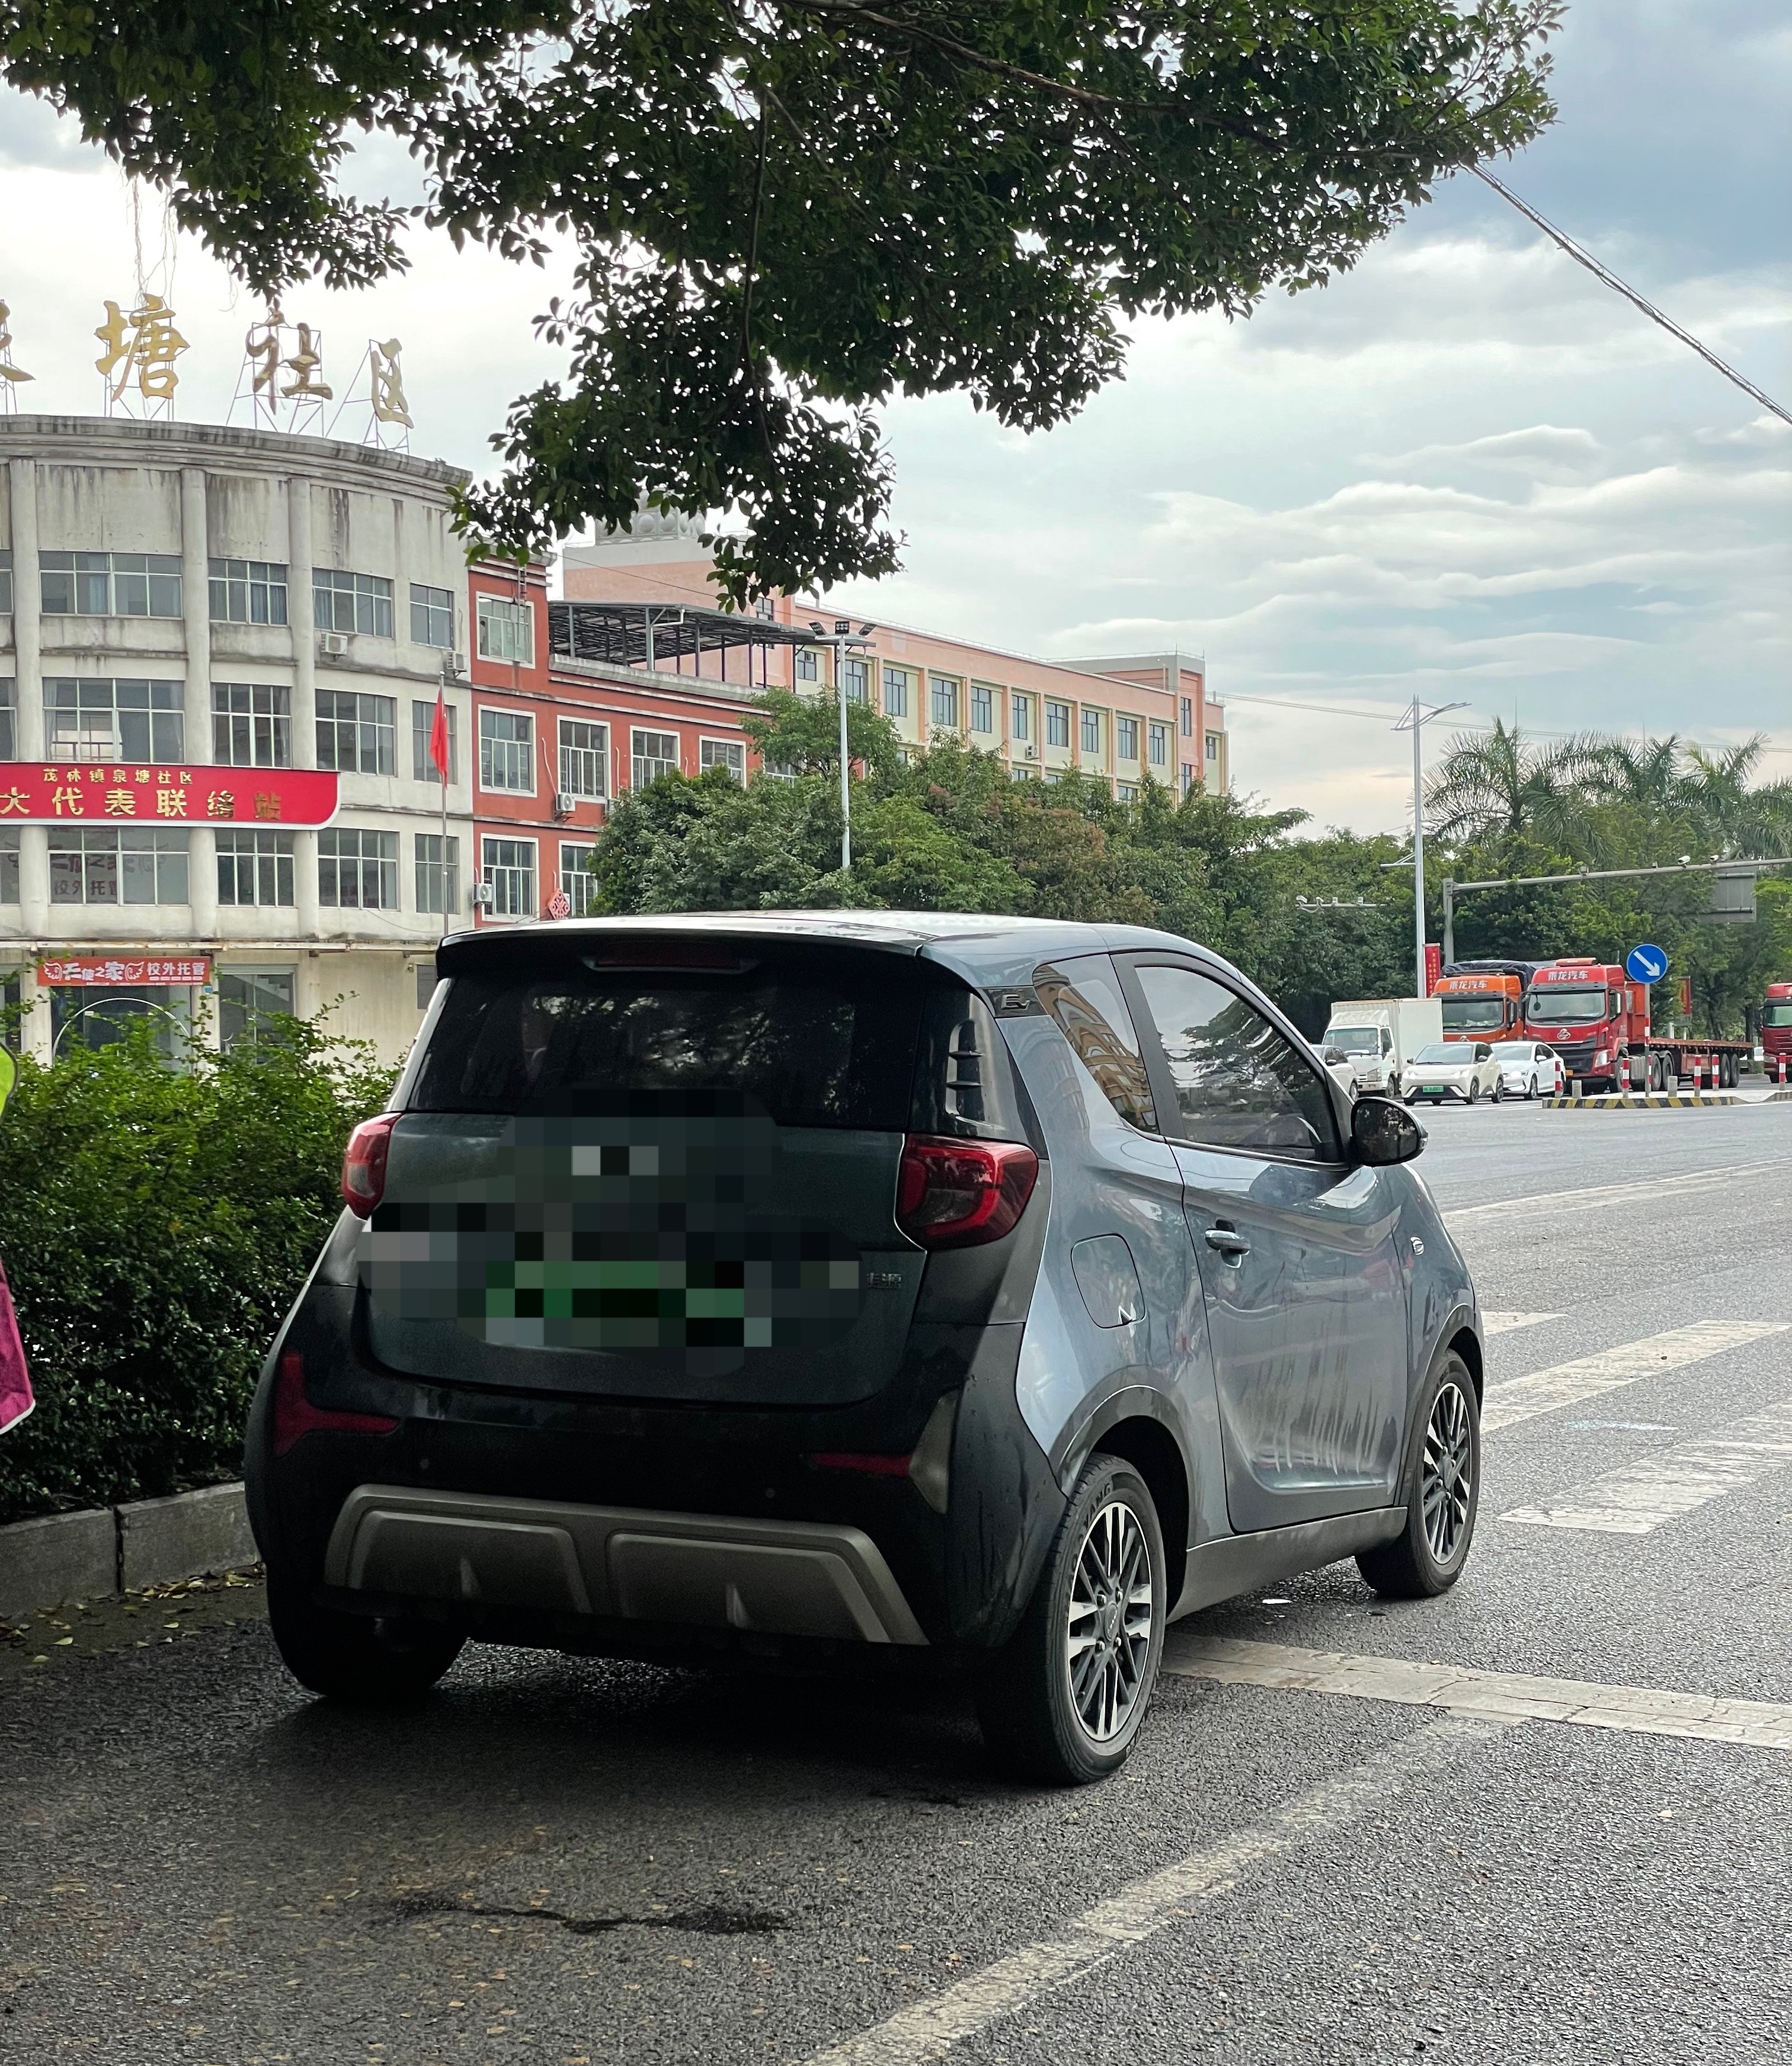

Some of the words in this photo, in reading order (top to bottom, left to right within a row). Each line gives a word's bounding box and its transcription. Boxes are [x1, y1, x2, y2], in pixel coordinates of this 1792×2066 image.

[0, 293, 414, 429] 塘社区
[147, 962, 206, 976] 校外托管
[1548, 970, 1589, 981] 乘龙汽车
[1449, 980, 1488, 990] 乘龙汽车
